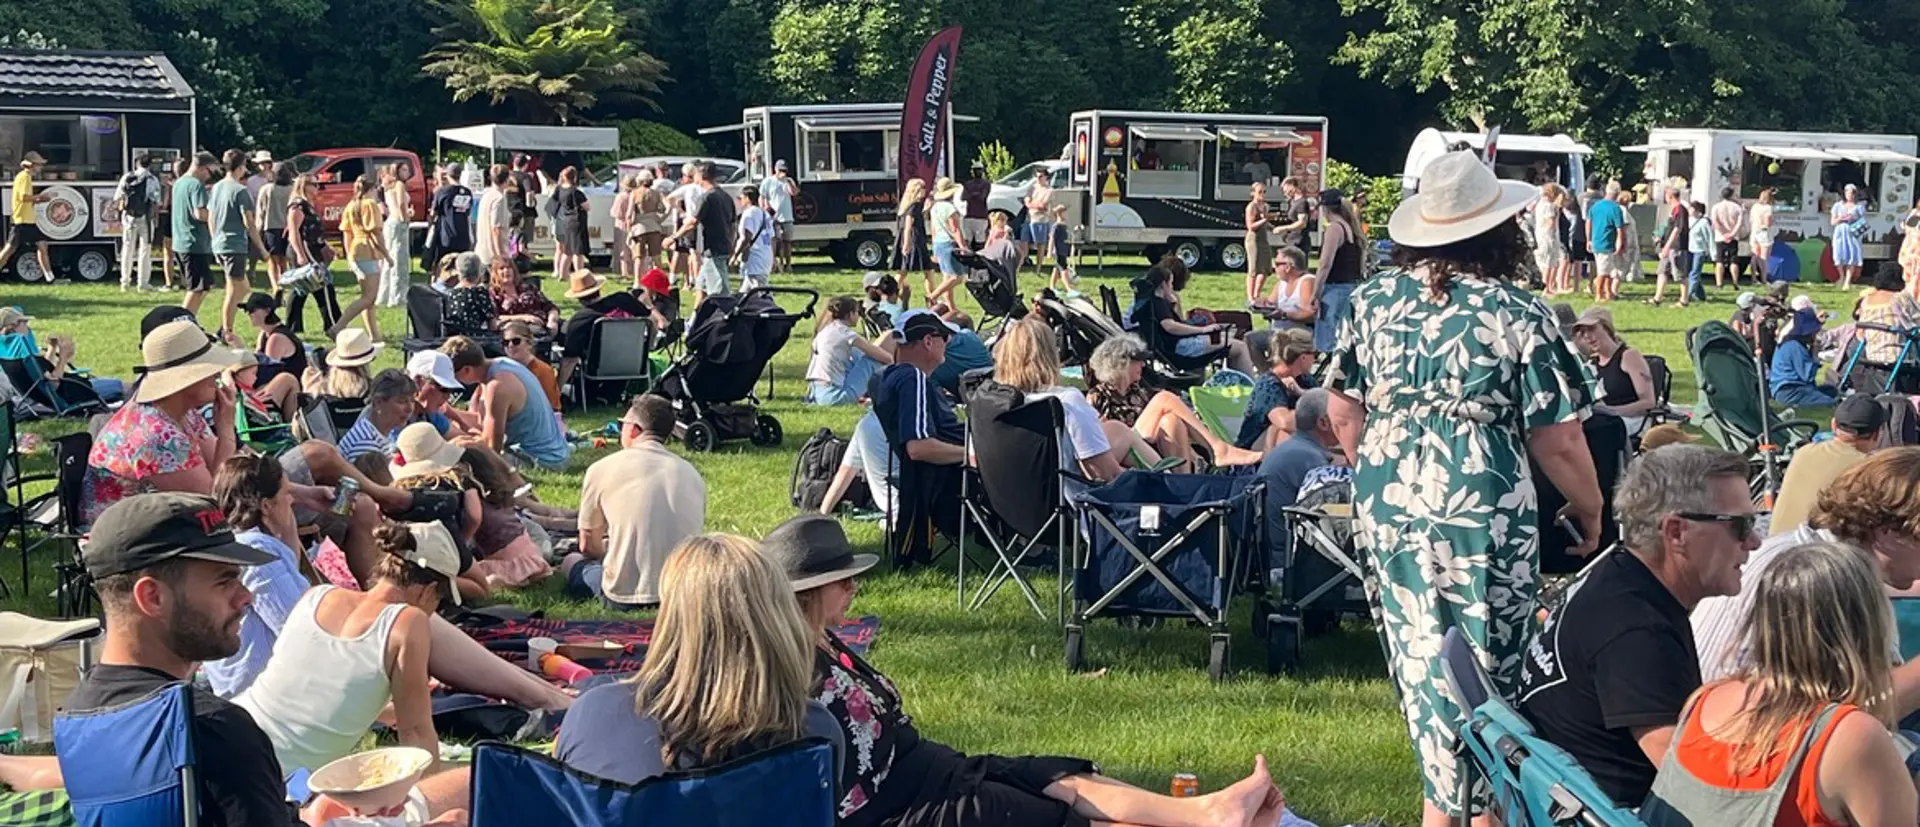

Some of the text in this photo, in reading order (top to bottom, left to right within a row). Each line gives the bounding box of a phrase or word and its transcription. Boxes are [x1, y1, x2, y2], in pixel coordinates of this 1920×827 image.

[919, 53, 947, 155] Salt & Pepper
[848, 193, 873, 206] Ceylon
